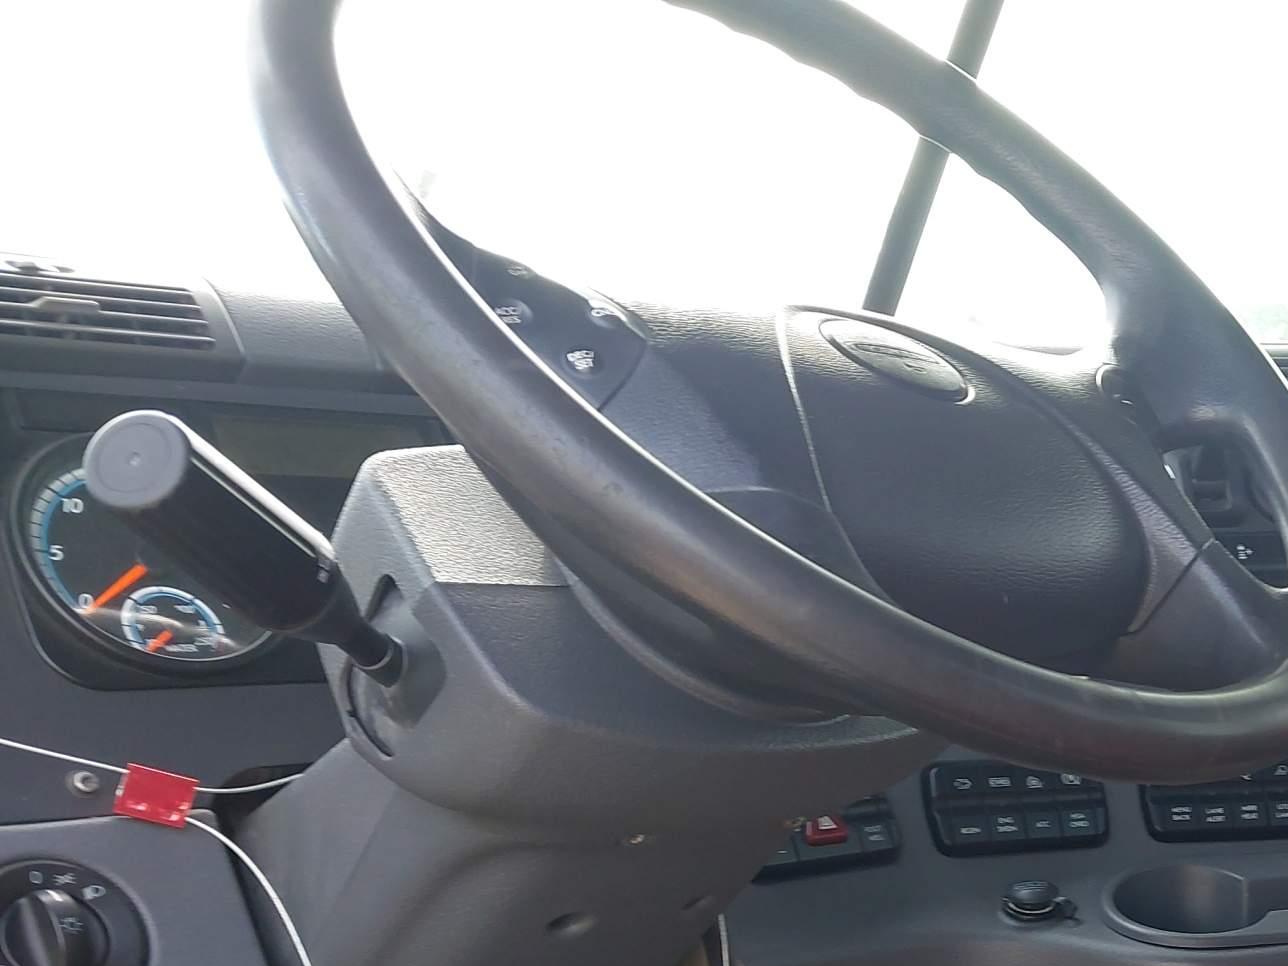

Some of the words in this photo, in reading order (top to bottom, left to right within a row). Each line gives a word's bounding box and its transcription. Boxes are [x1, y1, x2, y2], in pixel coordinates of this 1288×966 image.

[62, 498, 84, 514] 10
[49, 545, 65, 561] 5
[79, 593, 94, 609] 0
